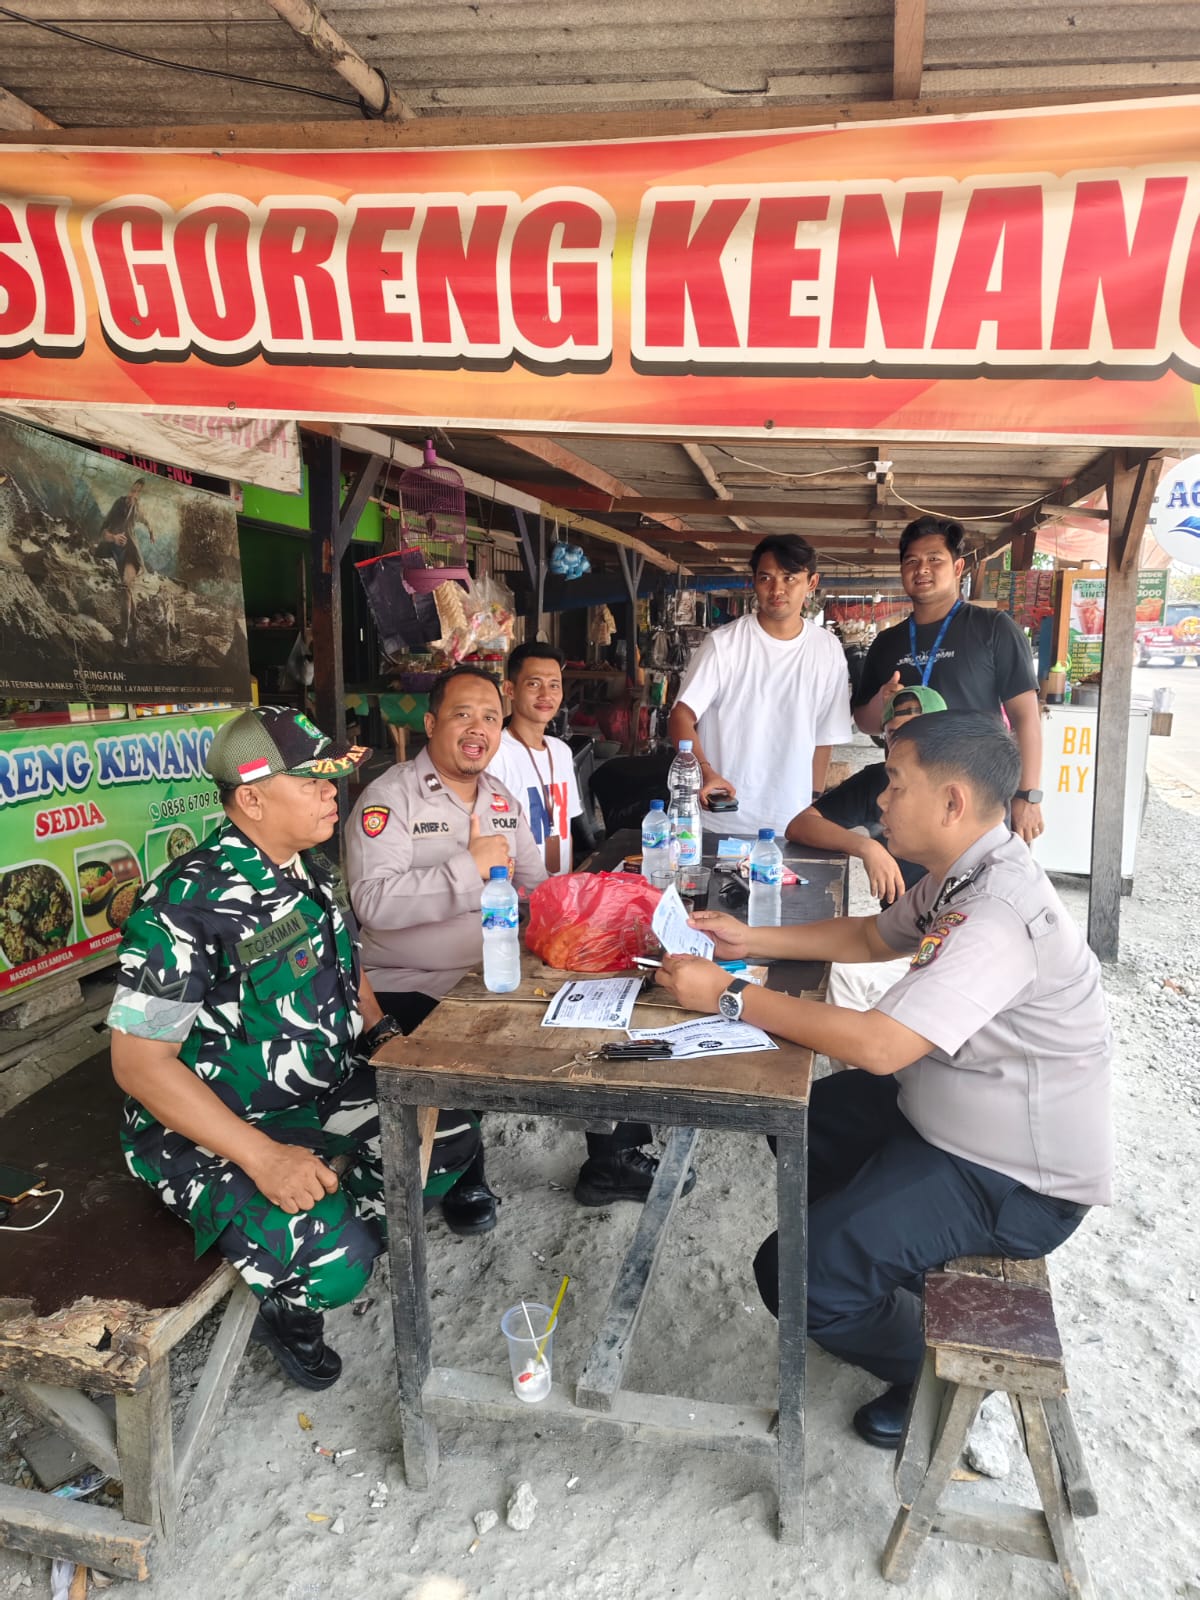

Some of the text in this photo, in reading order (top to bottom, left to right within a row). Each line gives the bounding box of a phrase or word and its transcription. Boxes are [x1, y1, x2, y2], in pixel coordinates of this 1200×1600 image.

[88, 193, 608, 358] GORENG
[35, 802, 105, 838] SEDIA
[161, 790, 221, 817] 0858 6709 8
[244, 917, 301, 955] TOEKIMAN
